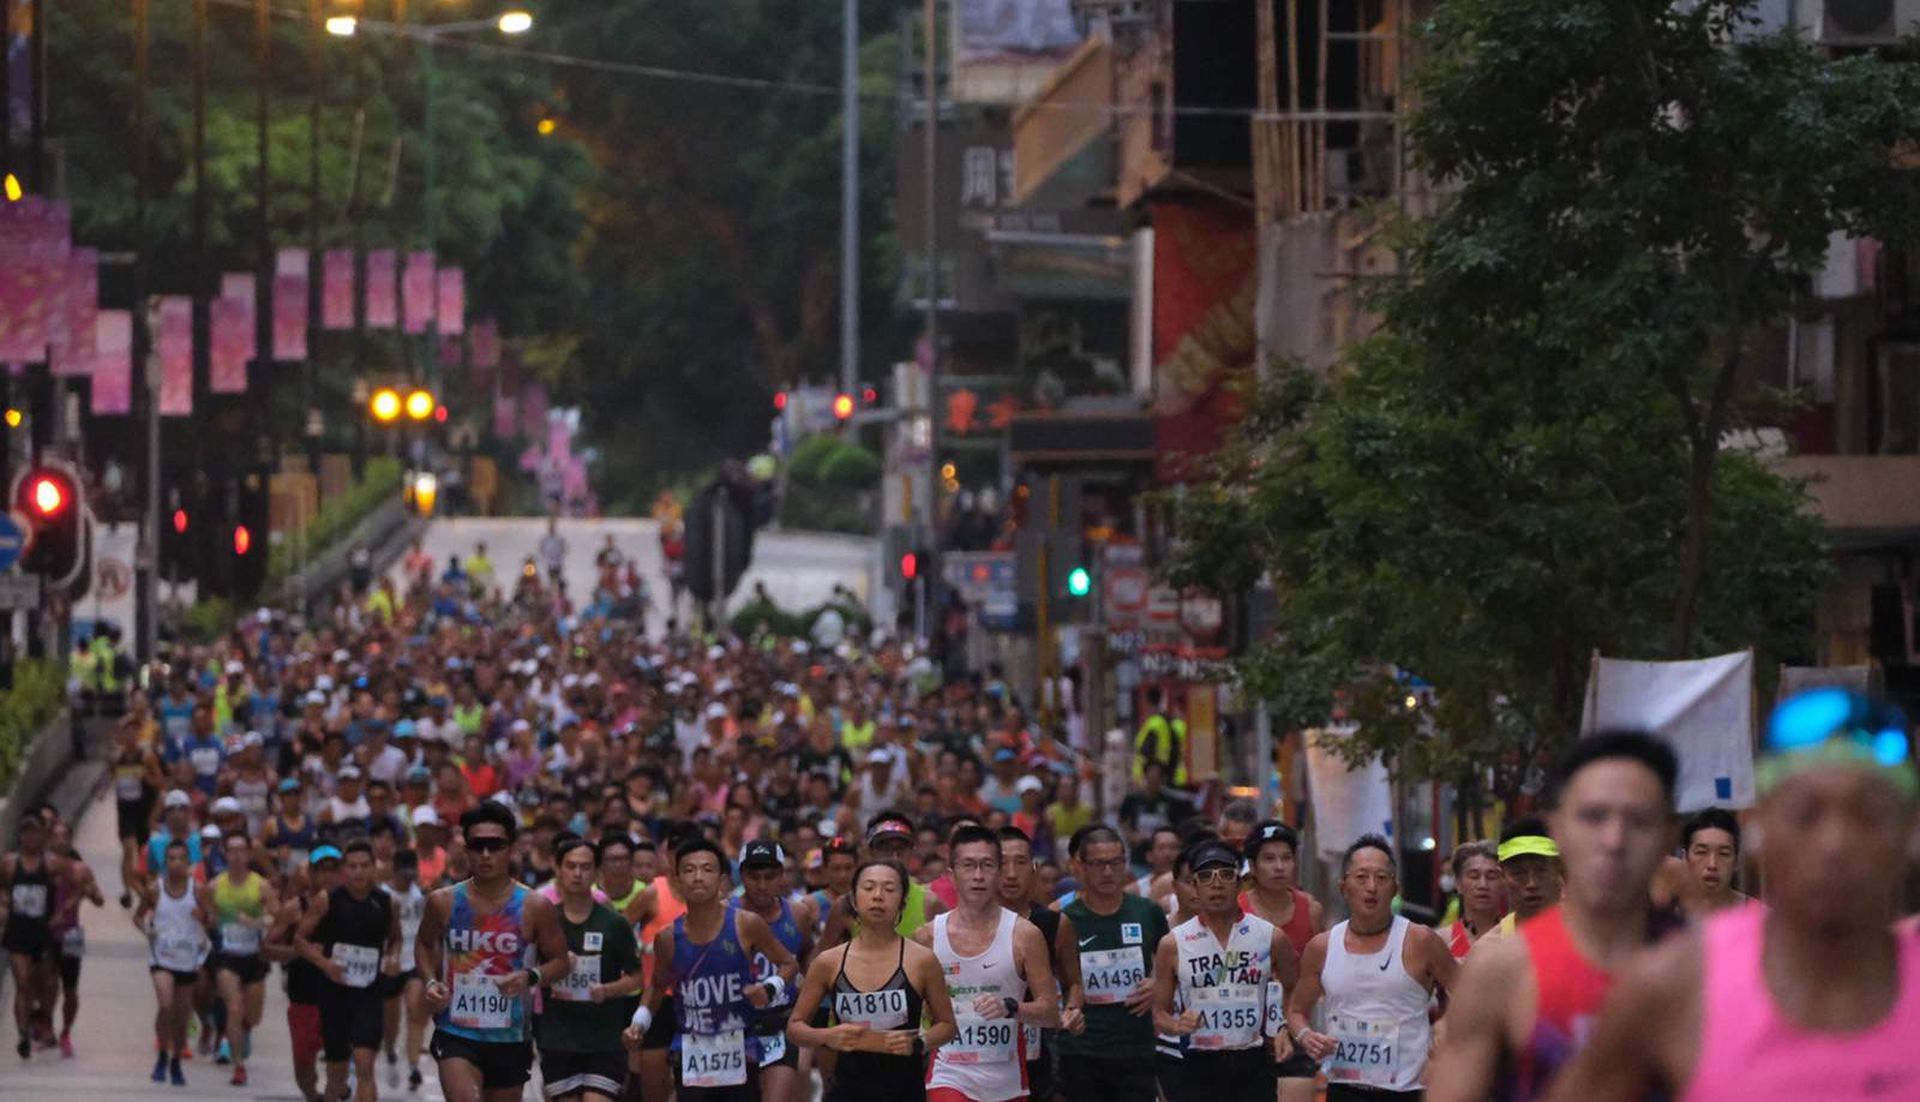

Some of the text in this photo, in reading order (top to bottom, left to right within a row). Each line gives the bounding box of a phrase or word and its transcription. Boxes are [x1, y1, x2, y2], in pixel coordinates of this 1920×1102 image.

[449, 928, 518, 954] HKG
[1188, 950, 1250, 974] TRANS
[680, 973, 743, 1007] MOVE
[1087, 967, 1142, 989] A1436
[456, 994, 509, 1013] A1190
[840, 991, 902, 1015] A1810
[950, 1024, 1011, 1046] A1590
[686, 1051, 743, 1073] A1575
[1335, 1041, 1392, 1065] A2751
